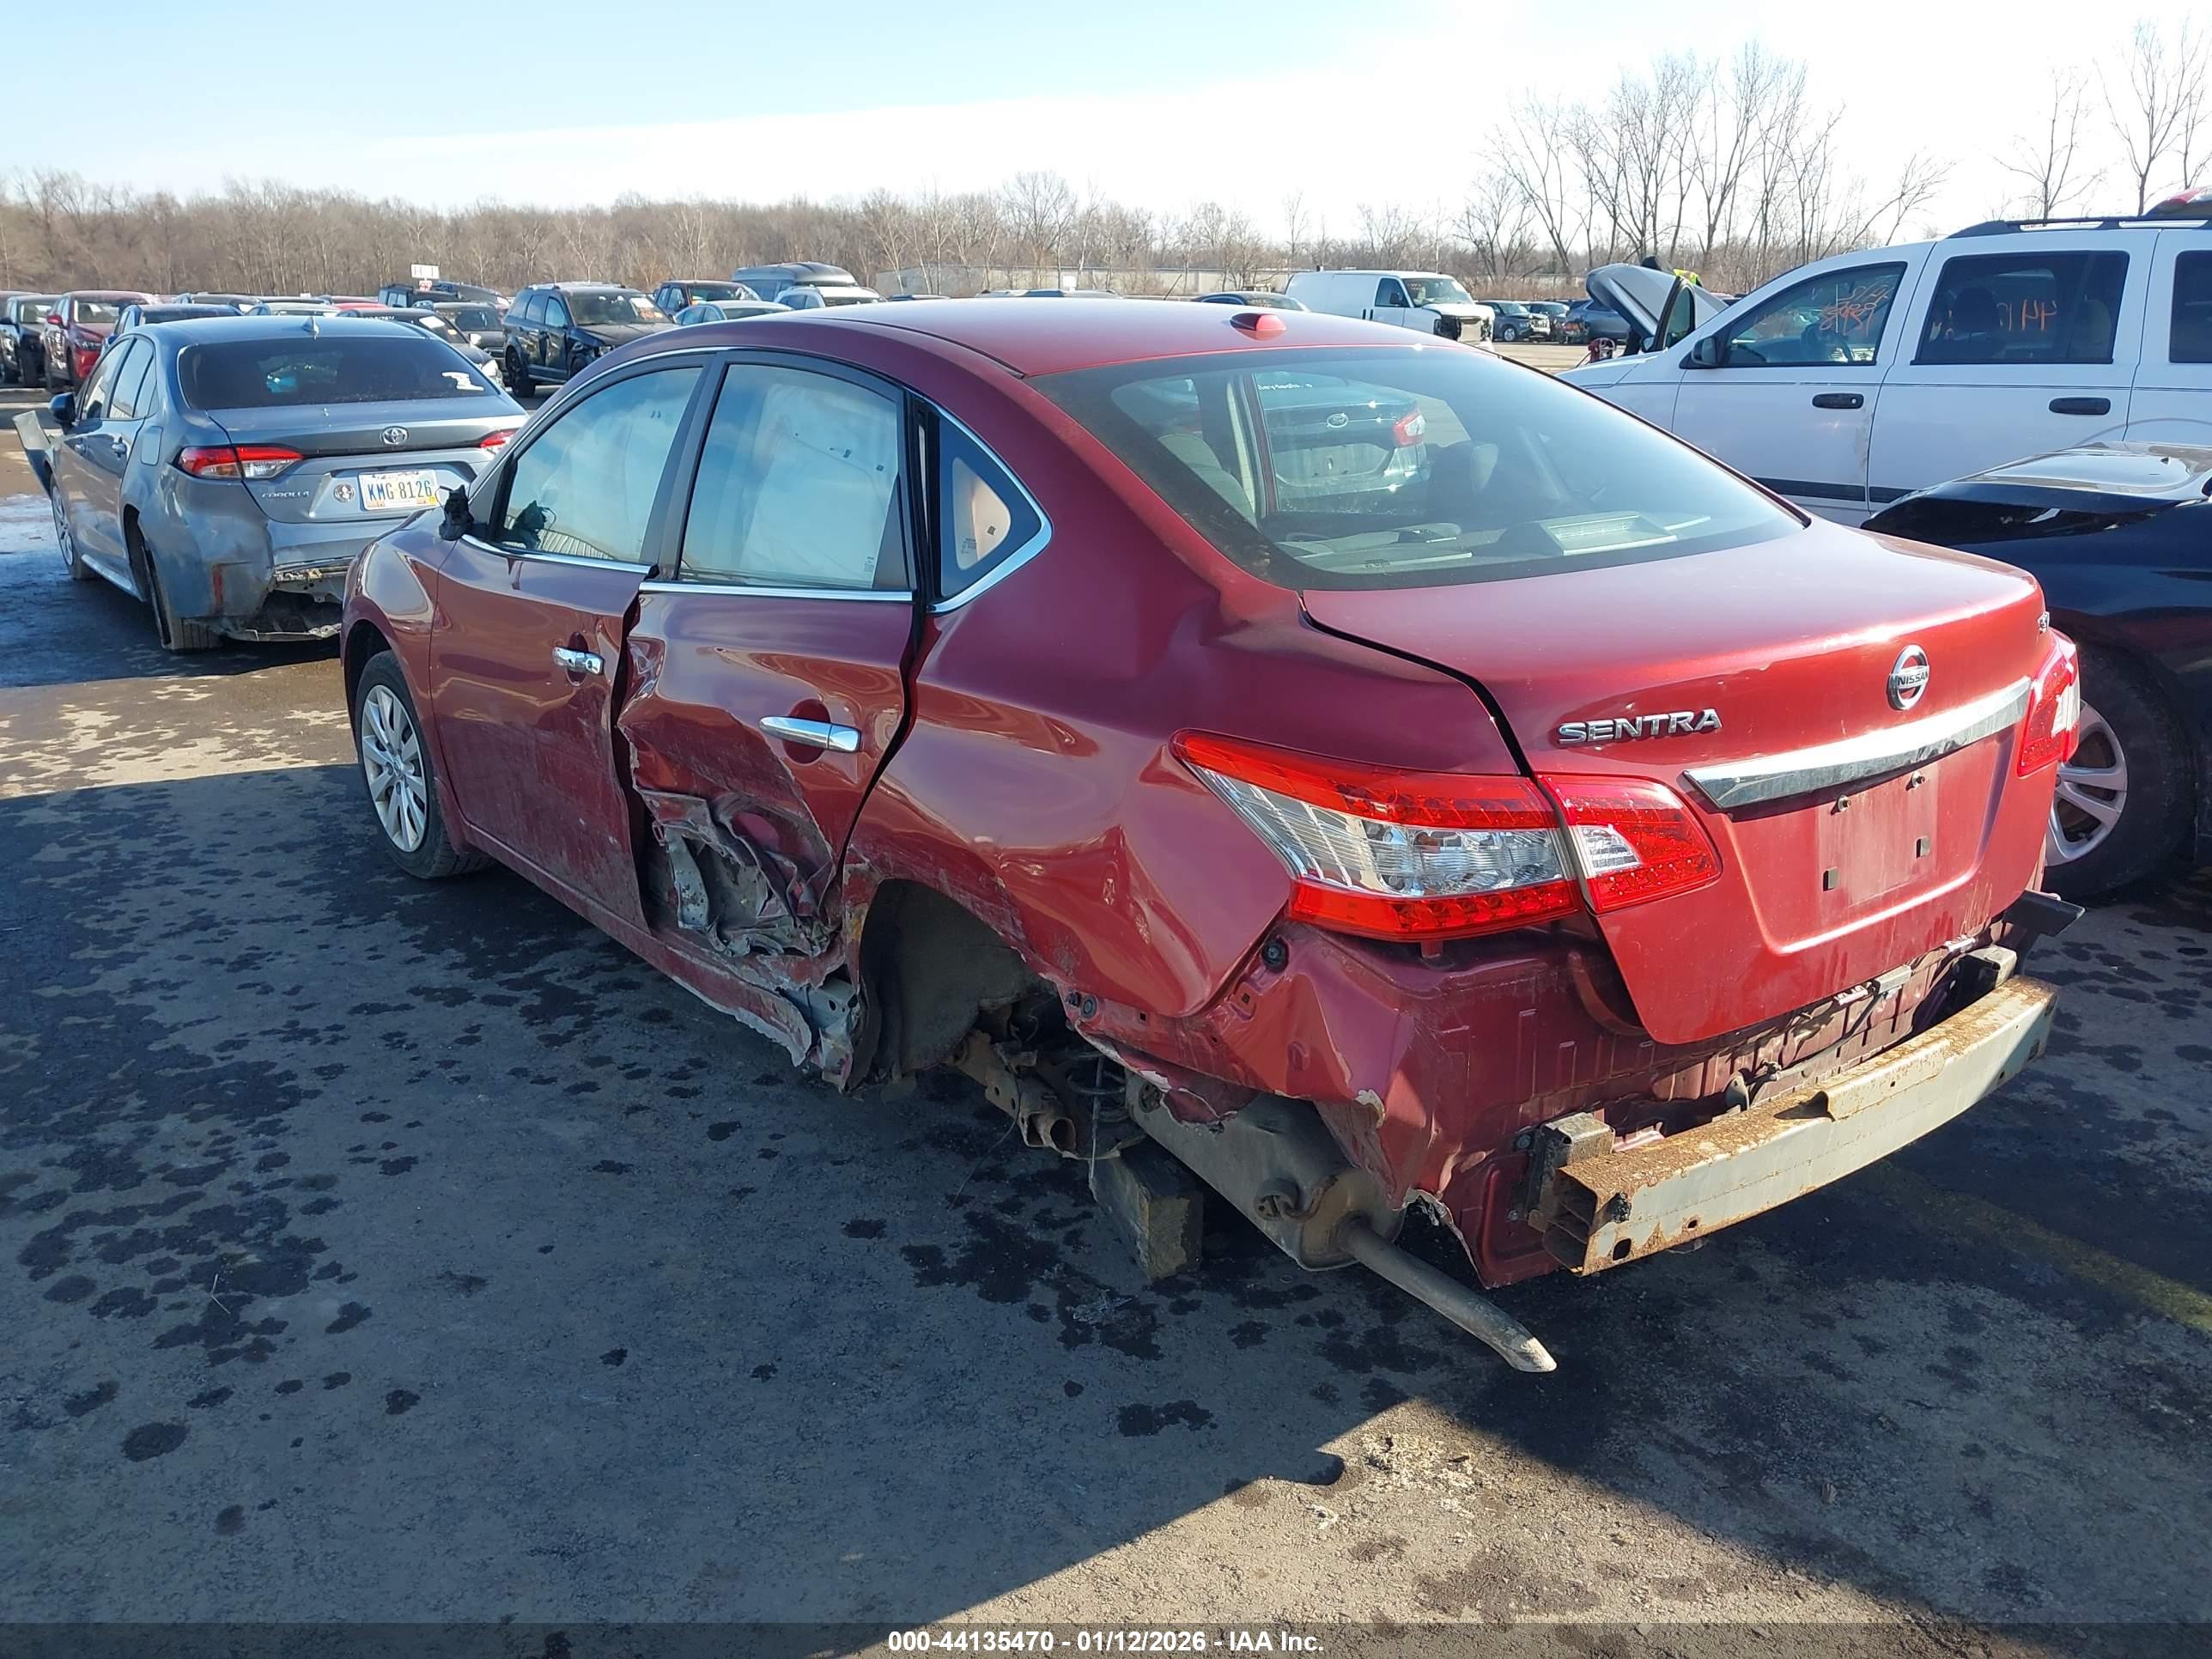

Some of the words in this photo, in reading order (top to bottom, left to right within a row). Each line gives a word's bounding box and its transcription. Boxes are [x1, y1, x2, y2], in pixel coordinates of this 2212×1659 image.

[367, 482, 395, 502] KMG
[398, 479, 433, 501] 8126
[1896, 671, 1929, 687] NISSAN
[1559, 708, 1723, 744] SENTRA
